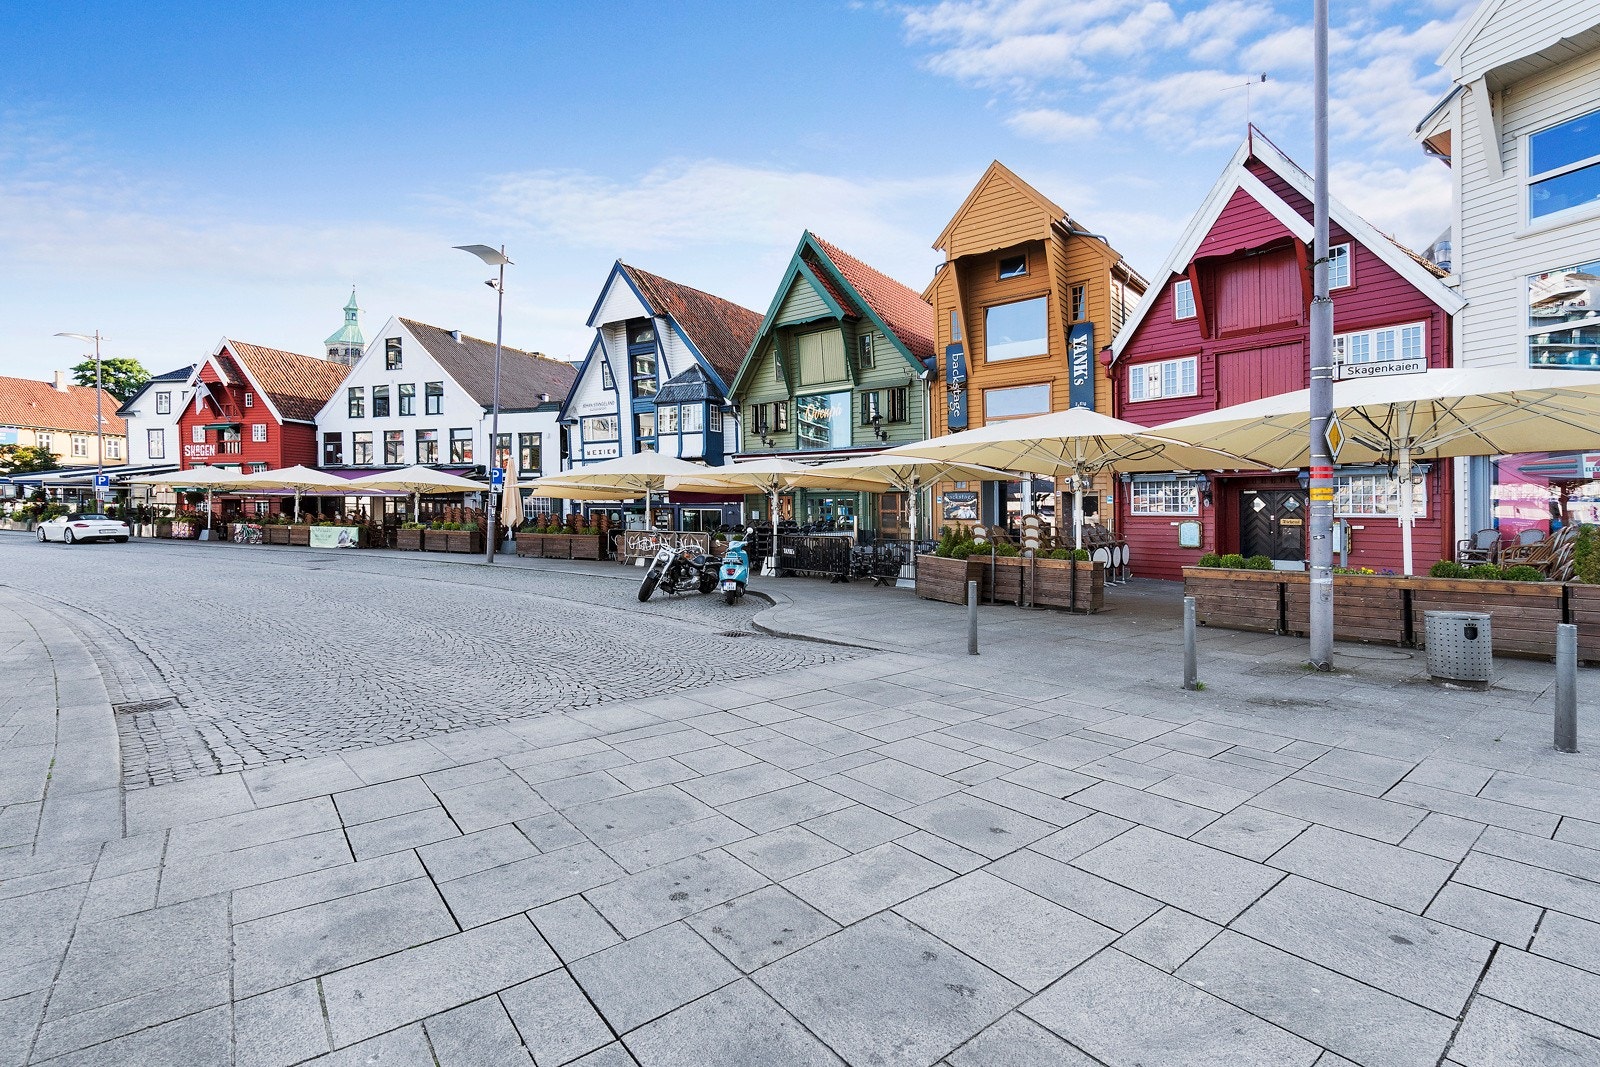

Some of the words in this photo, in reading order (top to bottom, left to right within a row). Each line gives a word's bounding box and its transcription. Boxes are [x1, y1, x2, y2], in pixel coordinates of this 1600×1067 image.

[1347, 362, 1419, 376] Skagenkaien
[950, 353, 965, 417] backstage
[98, 476, 106, 485] P
[492, 469, 500, 482] P
